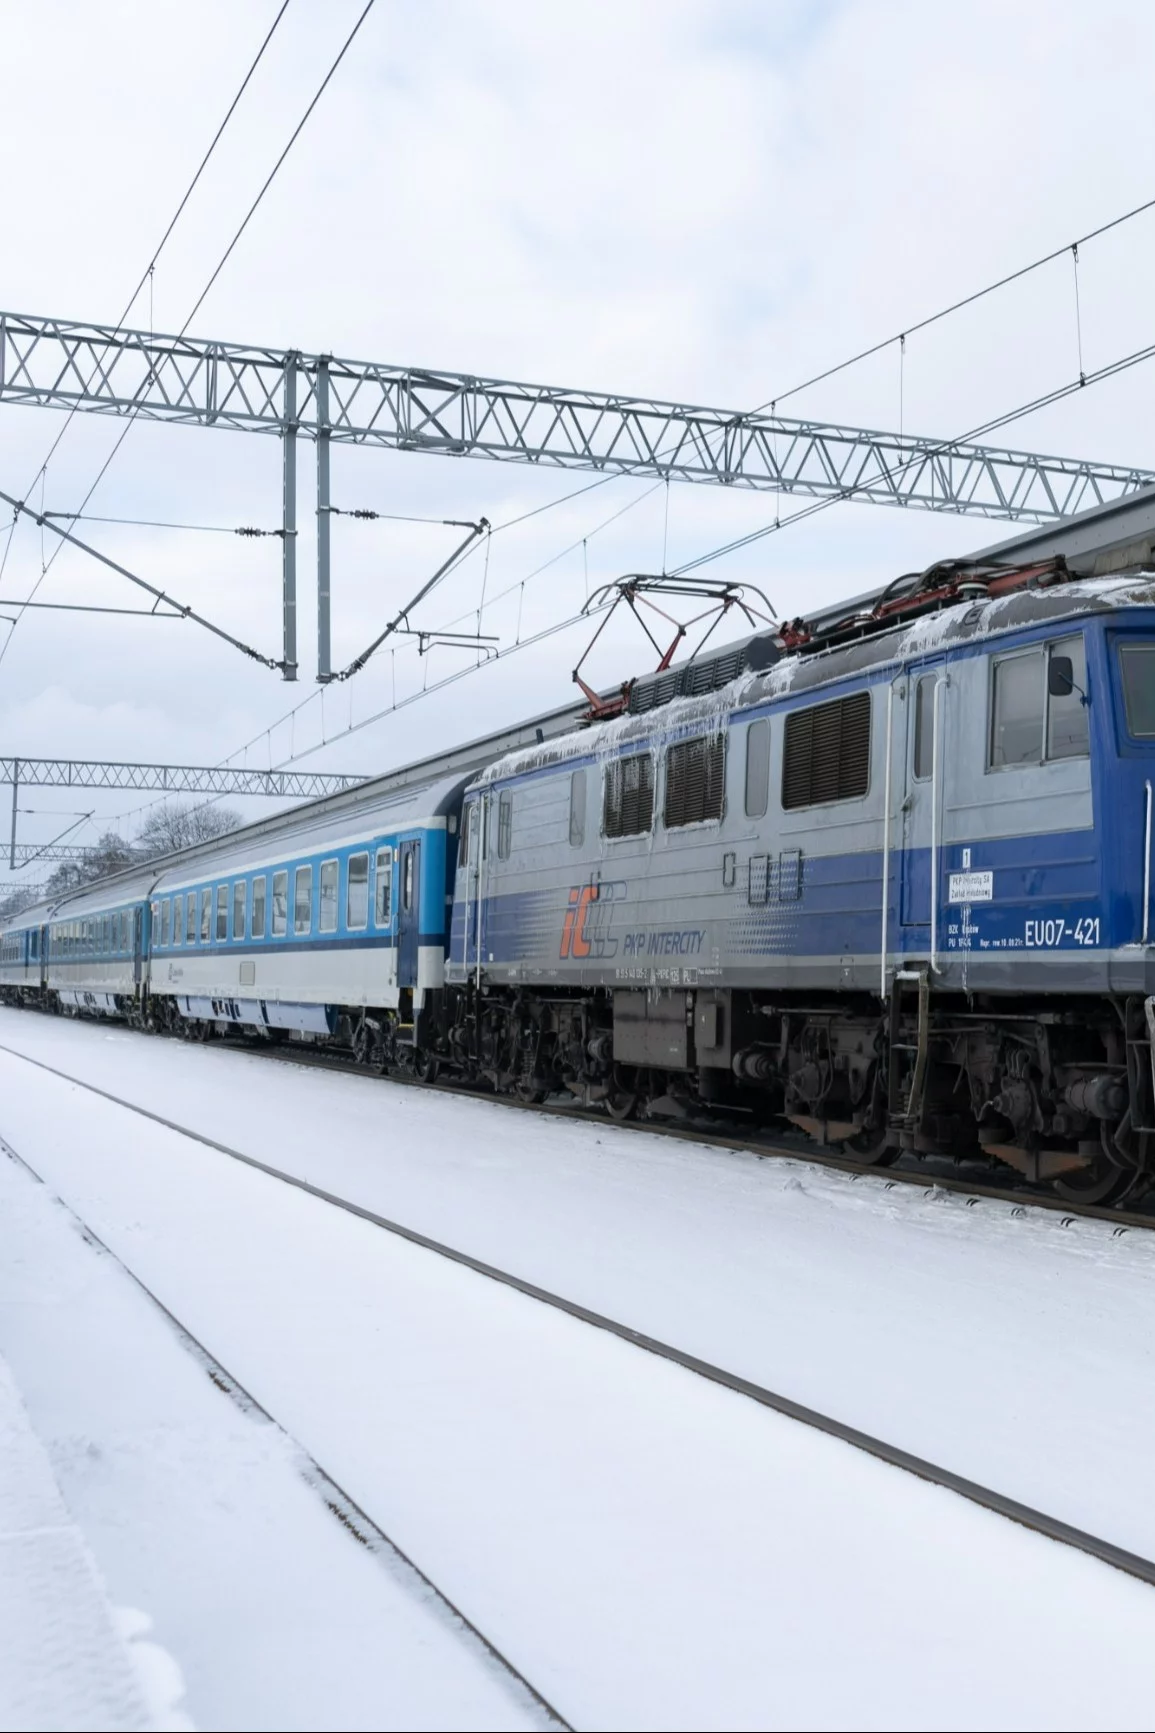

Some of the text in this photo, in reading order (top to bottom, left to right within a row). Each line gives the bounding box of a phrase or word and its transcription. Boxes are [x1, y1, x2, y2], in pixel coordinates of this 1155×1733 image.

[622, 929, 707, 956] PKP INTERCITY
[1025, 917, 1100, 946] EU07-421
